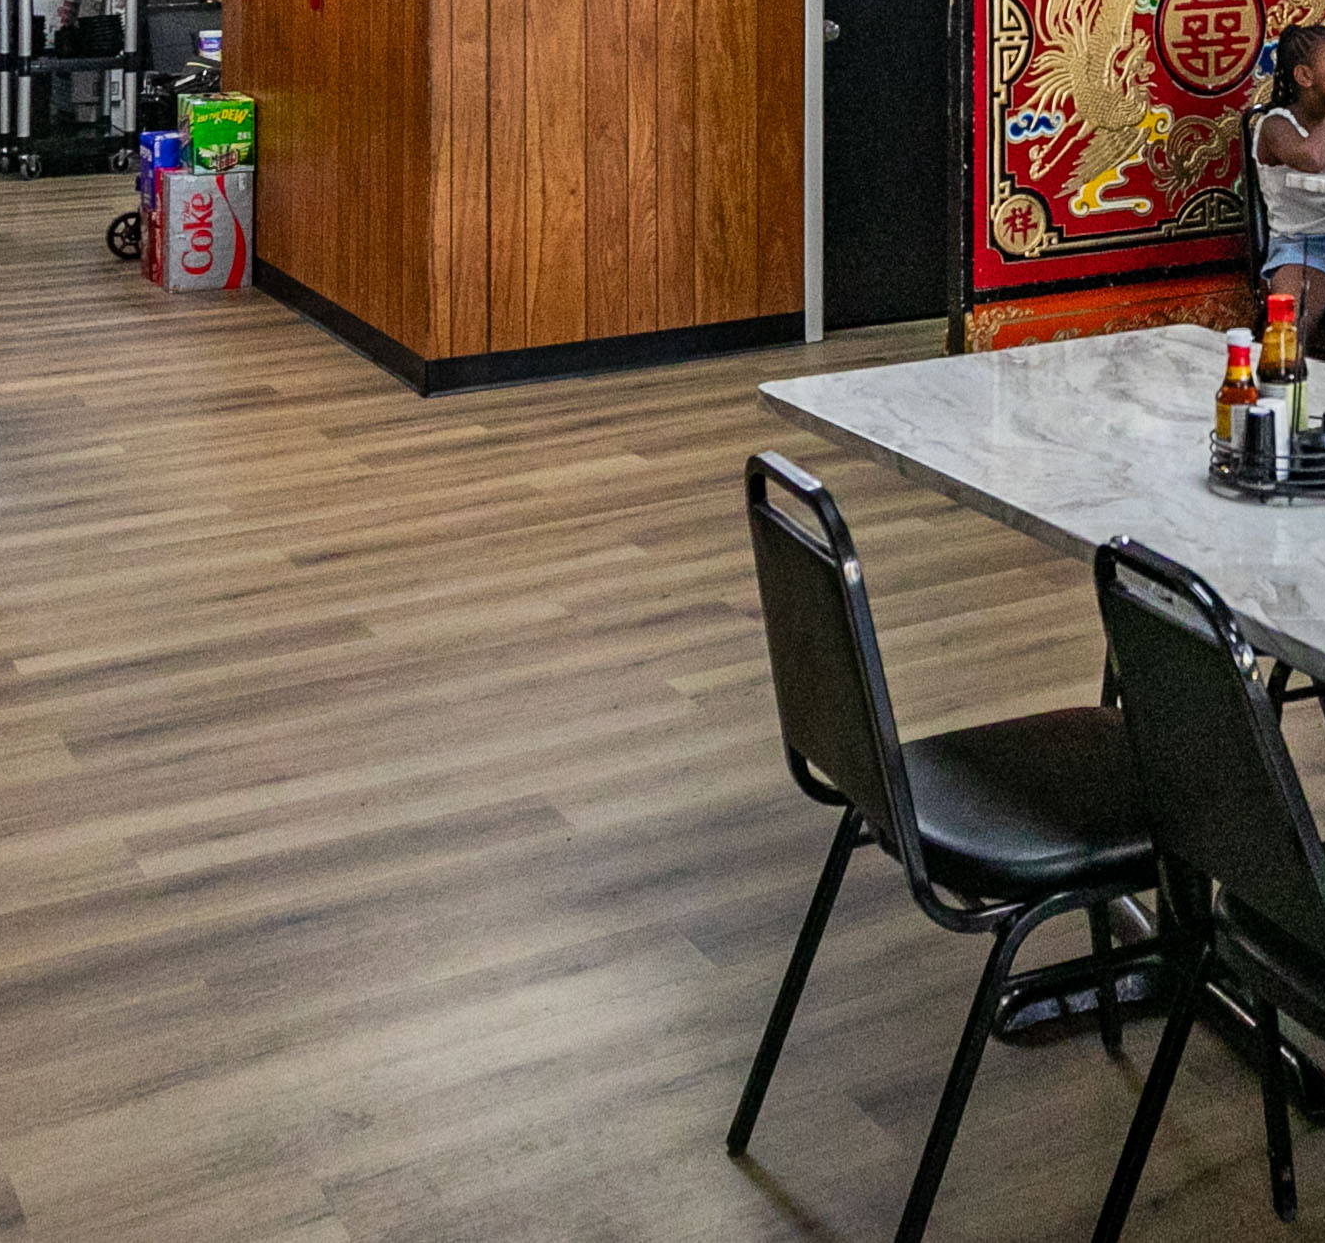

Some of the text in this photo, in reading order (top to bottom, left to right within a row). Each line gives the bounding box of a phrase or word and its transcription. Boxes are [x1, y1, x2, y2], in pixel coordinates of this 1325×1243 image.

[221, 108, 249, 124] DEW
[181, 192, 214, 276] Coke
[1003, 204, 1038, 246] 祥
